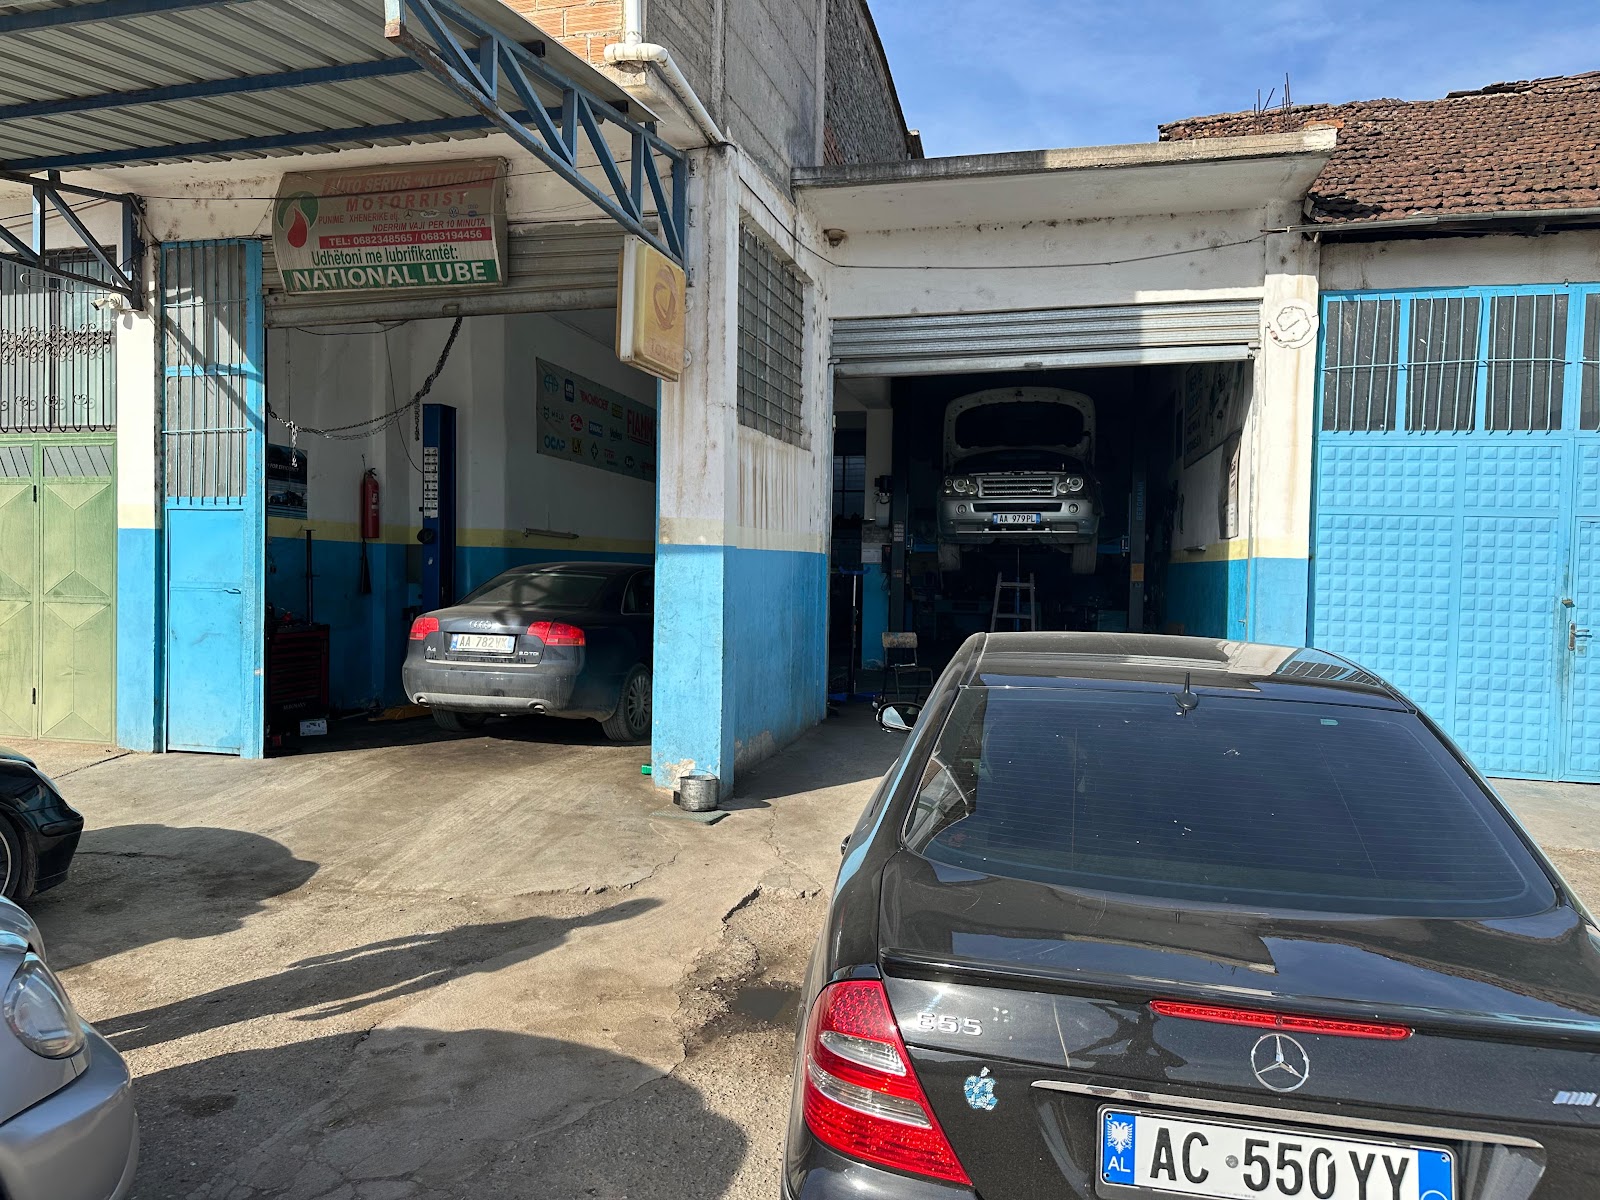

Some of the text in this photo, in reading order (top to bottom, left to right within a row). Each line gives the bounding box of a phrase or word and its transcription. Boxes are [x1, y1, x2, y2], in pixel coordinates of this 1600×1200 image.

[364, 175, 411, 192] SERVIS
[347, 192, 467, 212] MOTORRIST
[318, 214, 344, 225] PUNIME
[349, 212, 388, 223] XHENERIKE
[372, 222, 407, 233] NDERRIM
[428, 220, 444, 229] PER
[445, 219, 455, 229] 10
[456, 217, 486, 228] MINUTA
[329, 237, 351, 246] TEL:
[353, 233, 413, 246] 0682348565
[420, 230, 483, 242] 0683194456
[311, 244, 459, 267] Udhëtoni me lubrifikantët:
[291, 261, 487, 291] NATIONAL LUBE
[999, 514, 1008, 523] AA
[459, 635, 471, 647] AA
[1148, 1126, 1210, 1185] AC
[1107, 1156, 1132, 1173] AL
